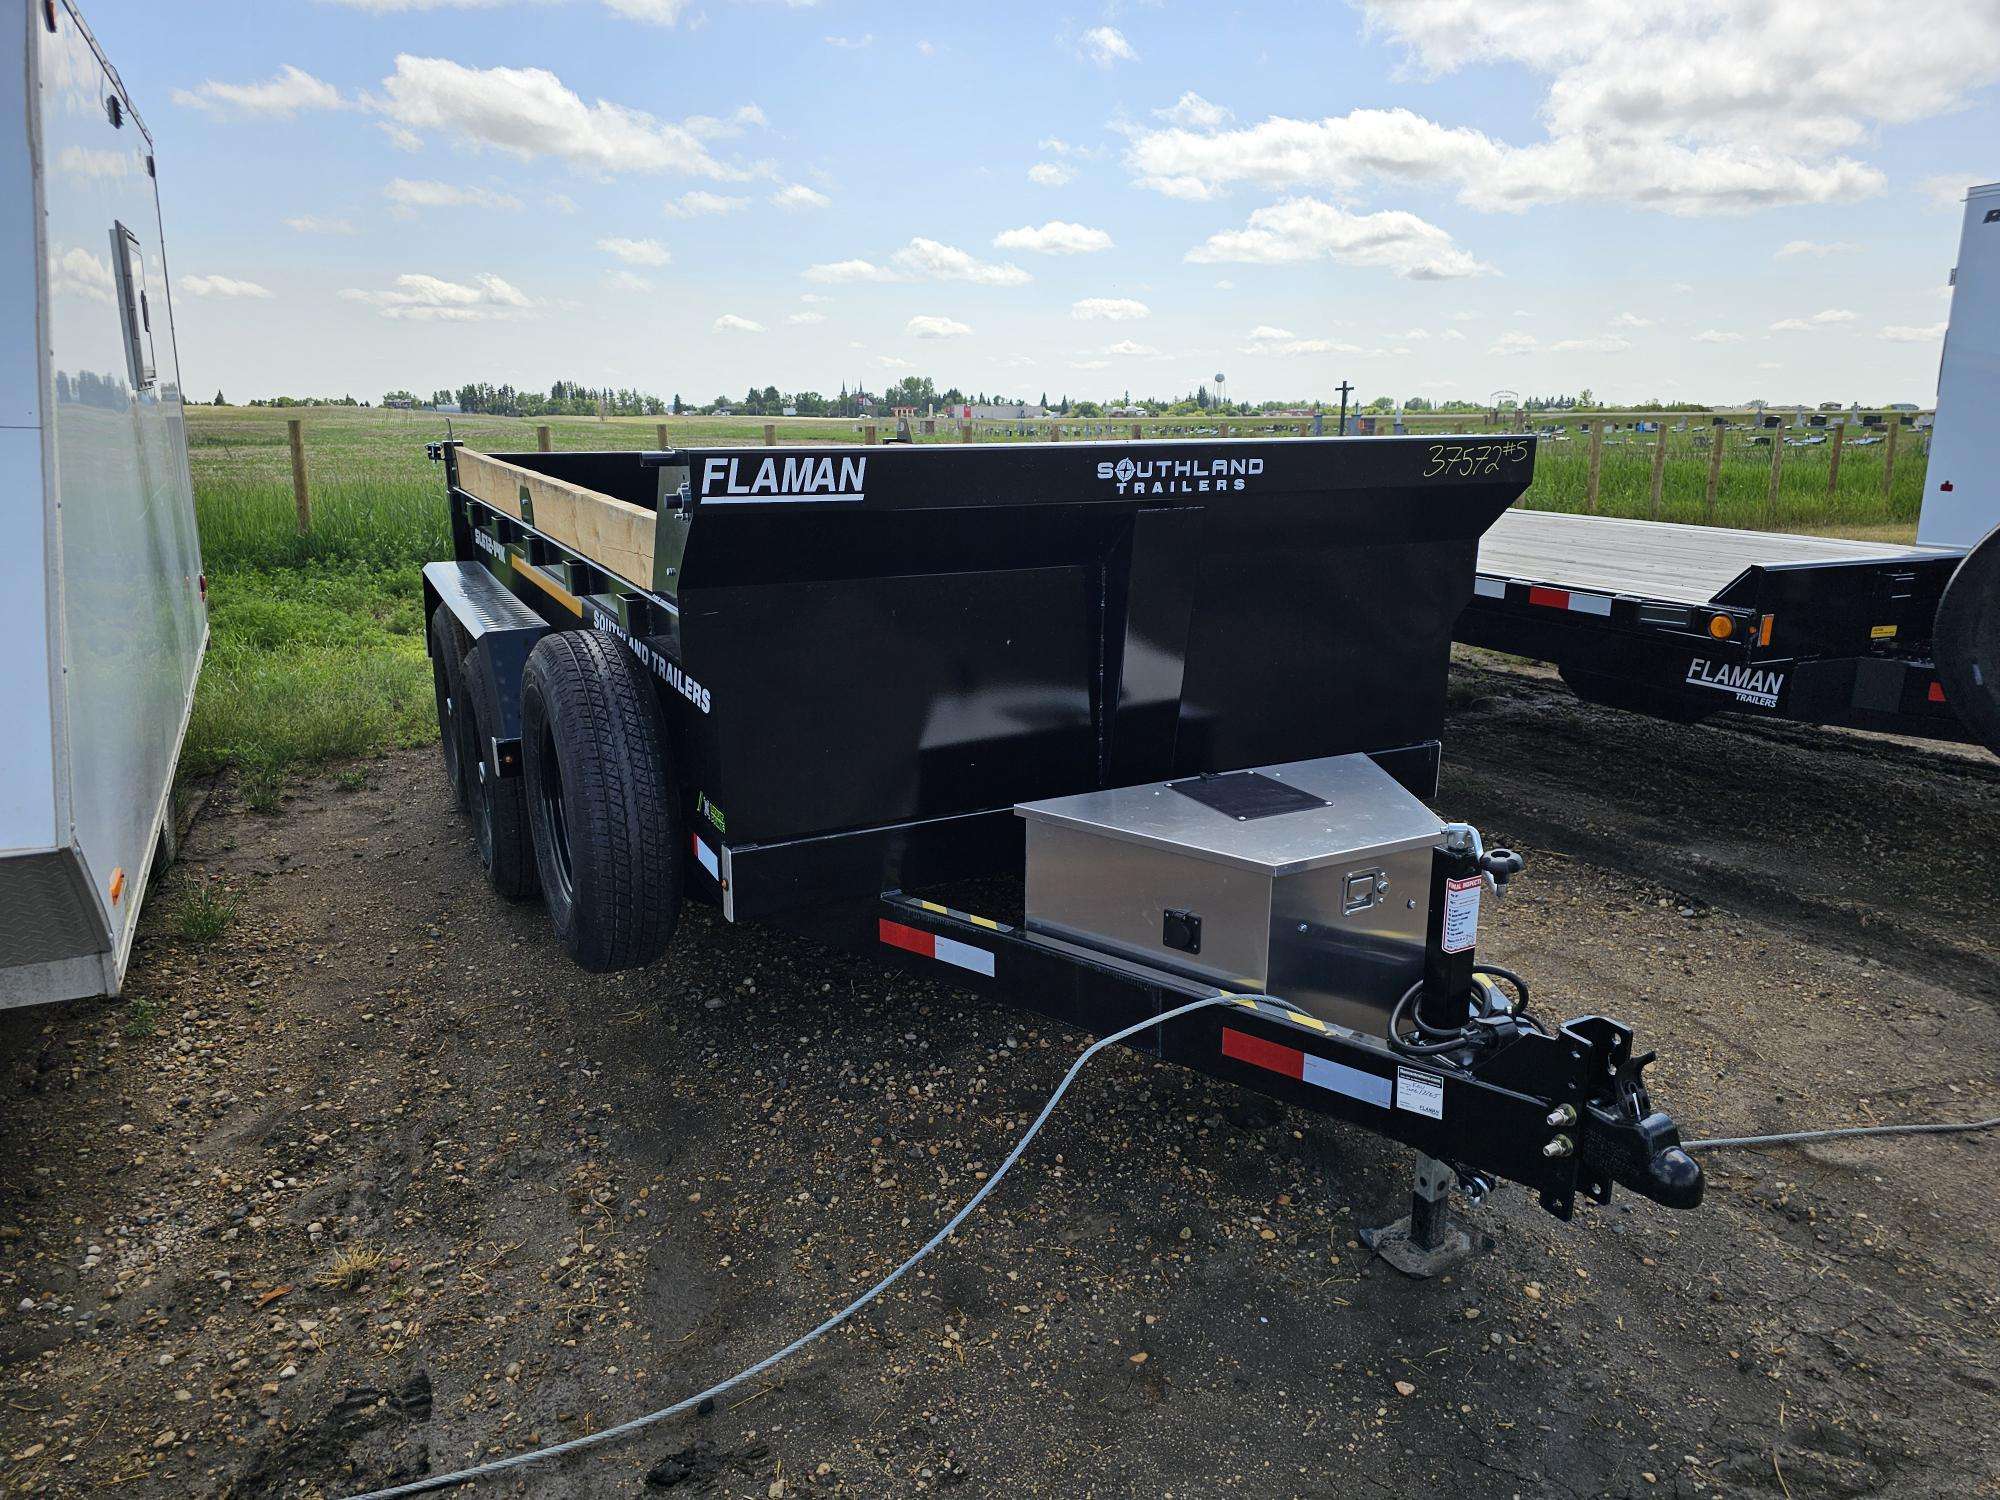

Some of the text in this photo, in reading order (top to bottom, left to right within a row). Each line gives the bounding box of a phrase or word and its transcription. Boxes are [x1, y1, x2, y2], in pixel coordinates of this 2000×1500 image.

[701, 457, 867, 494] FLAMAN
[1097, 457, 1264, 482] SOUTHLAND
[1116, 478, 1246, 495] TRAILERS
[651, 650, 711, 714] TRAILERS
[1687, 657, 1784, 695] FLAMAN
[1736, 692, 1777, 708] TRAILERS
